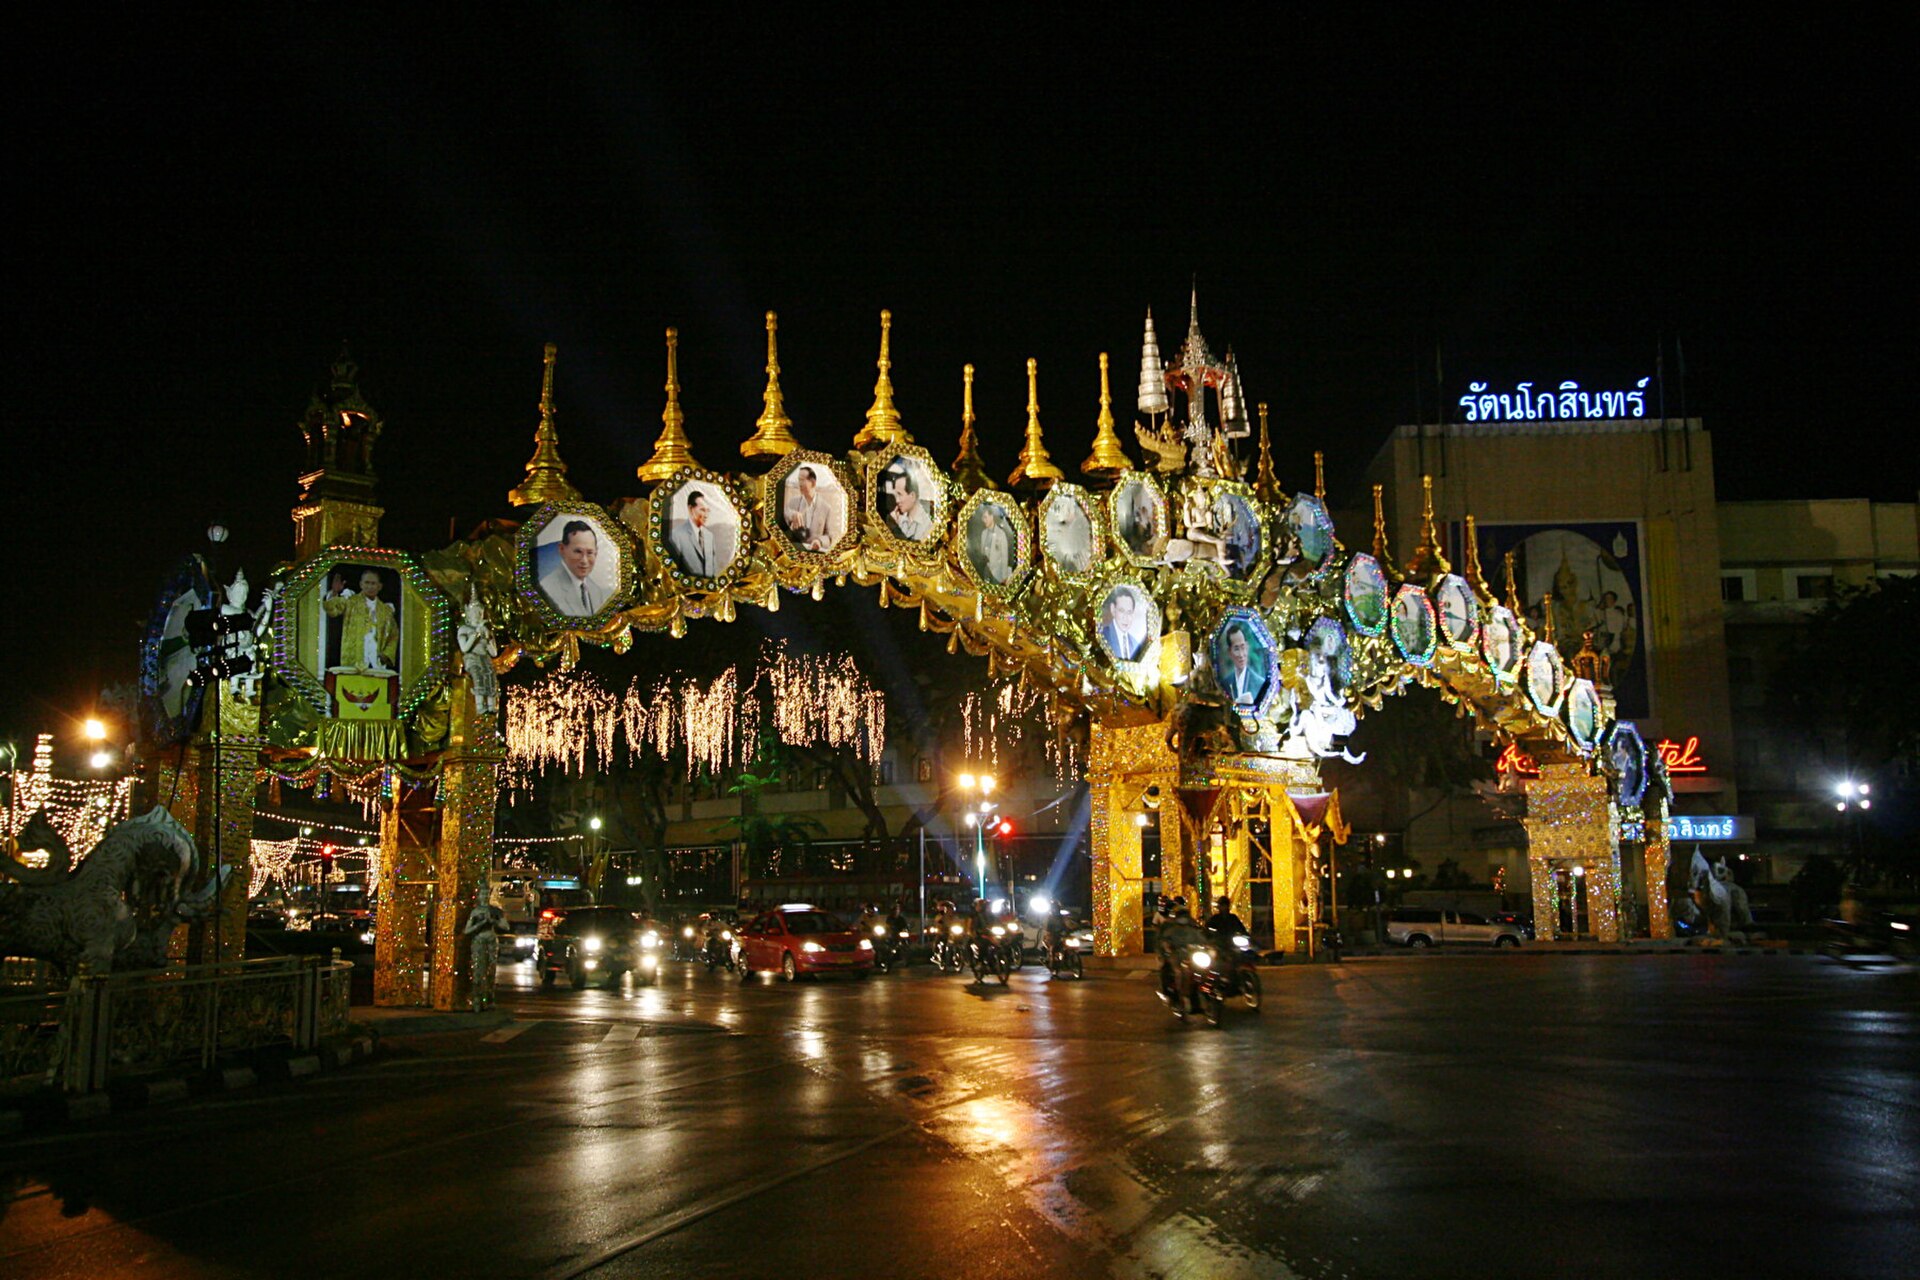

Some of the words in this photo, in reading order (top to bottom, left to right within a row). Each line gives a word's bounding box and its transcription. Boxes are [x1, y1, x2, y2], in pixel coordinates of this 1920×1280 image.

[1459, 376, 1650, 422] รัตนโกสินทร์
[1658, 737, 1701, 766] tel
[1668, 818, 1733, 837] กสินทร์
